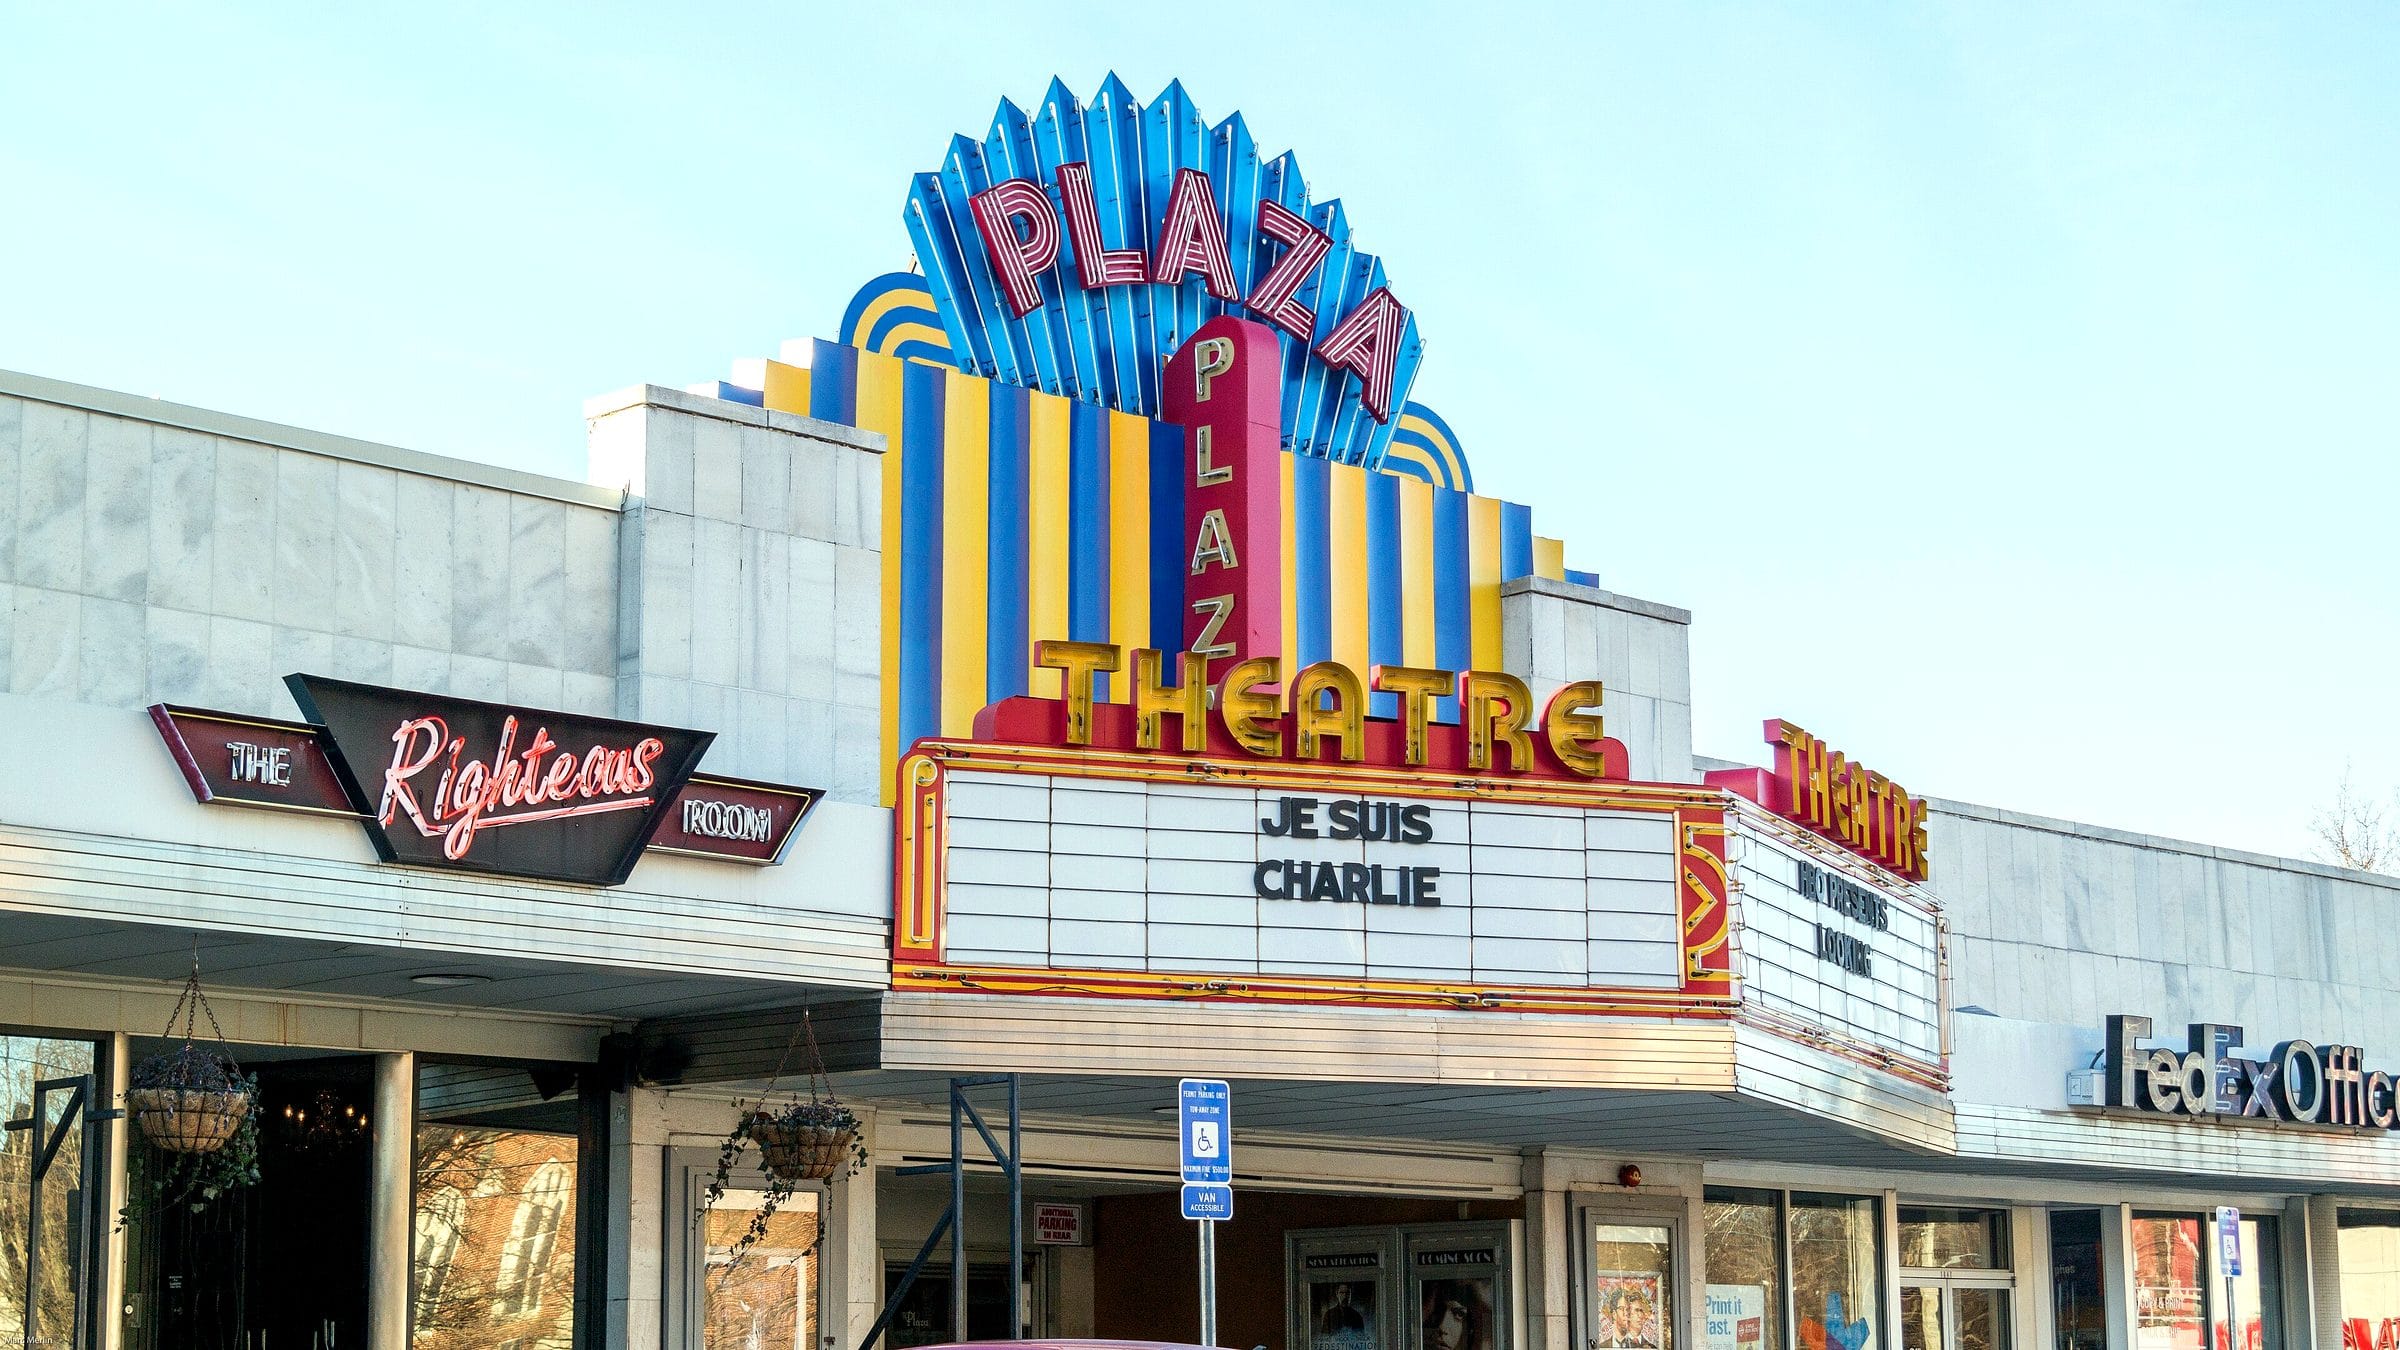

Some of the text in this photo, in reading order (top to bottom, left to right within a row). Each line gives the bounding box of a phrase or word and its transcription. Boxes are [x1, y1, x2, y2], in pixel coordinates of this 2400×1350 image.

[969, 161, 1403, 425] PLAZA
[1191, 336, 1239, 711] PLAZ
[1034, 640, 1606, 778] THEATRE
[226, 714, 772, 860] THE Righteous ROOM
[1763, 718, 1929, 882] THEATRE
[1261, 796, 1434, 844] JE SUIS
[1253, 858, 1442, 907] CHARLIE
[1826, 871, 1889, 932] PRESENTS
[1816, 922, 1872, 978] LOOKING
[2105, 1014, 2282, 1120] FedEx
[1183, 1090, 1226, 1099] PERMIT PARKING ONLY
[1210, 1106, 1220, 1114] ZONE
[1184, 1165, 1201, 1173] MAXIMUM
[1201, 1165, 1211, 1173] FINE
[1041, 1207, 1074, 1218] ADDITIONAL
[1190, 1204, 1225, 1212] ACCESSIBLE
[1198, 1192, 1216, 1203] VAN
[1038, 1216, 1077, 1231] PARKING
[1043, 1230, 1072, 1240] IN REAR
[1421, 1252, 1491, 1265] COMING SOON
[1705, 1294, 1742, 1315] Print it
